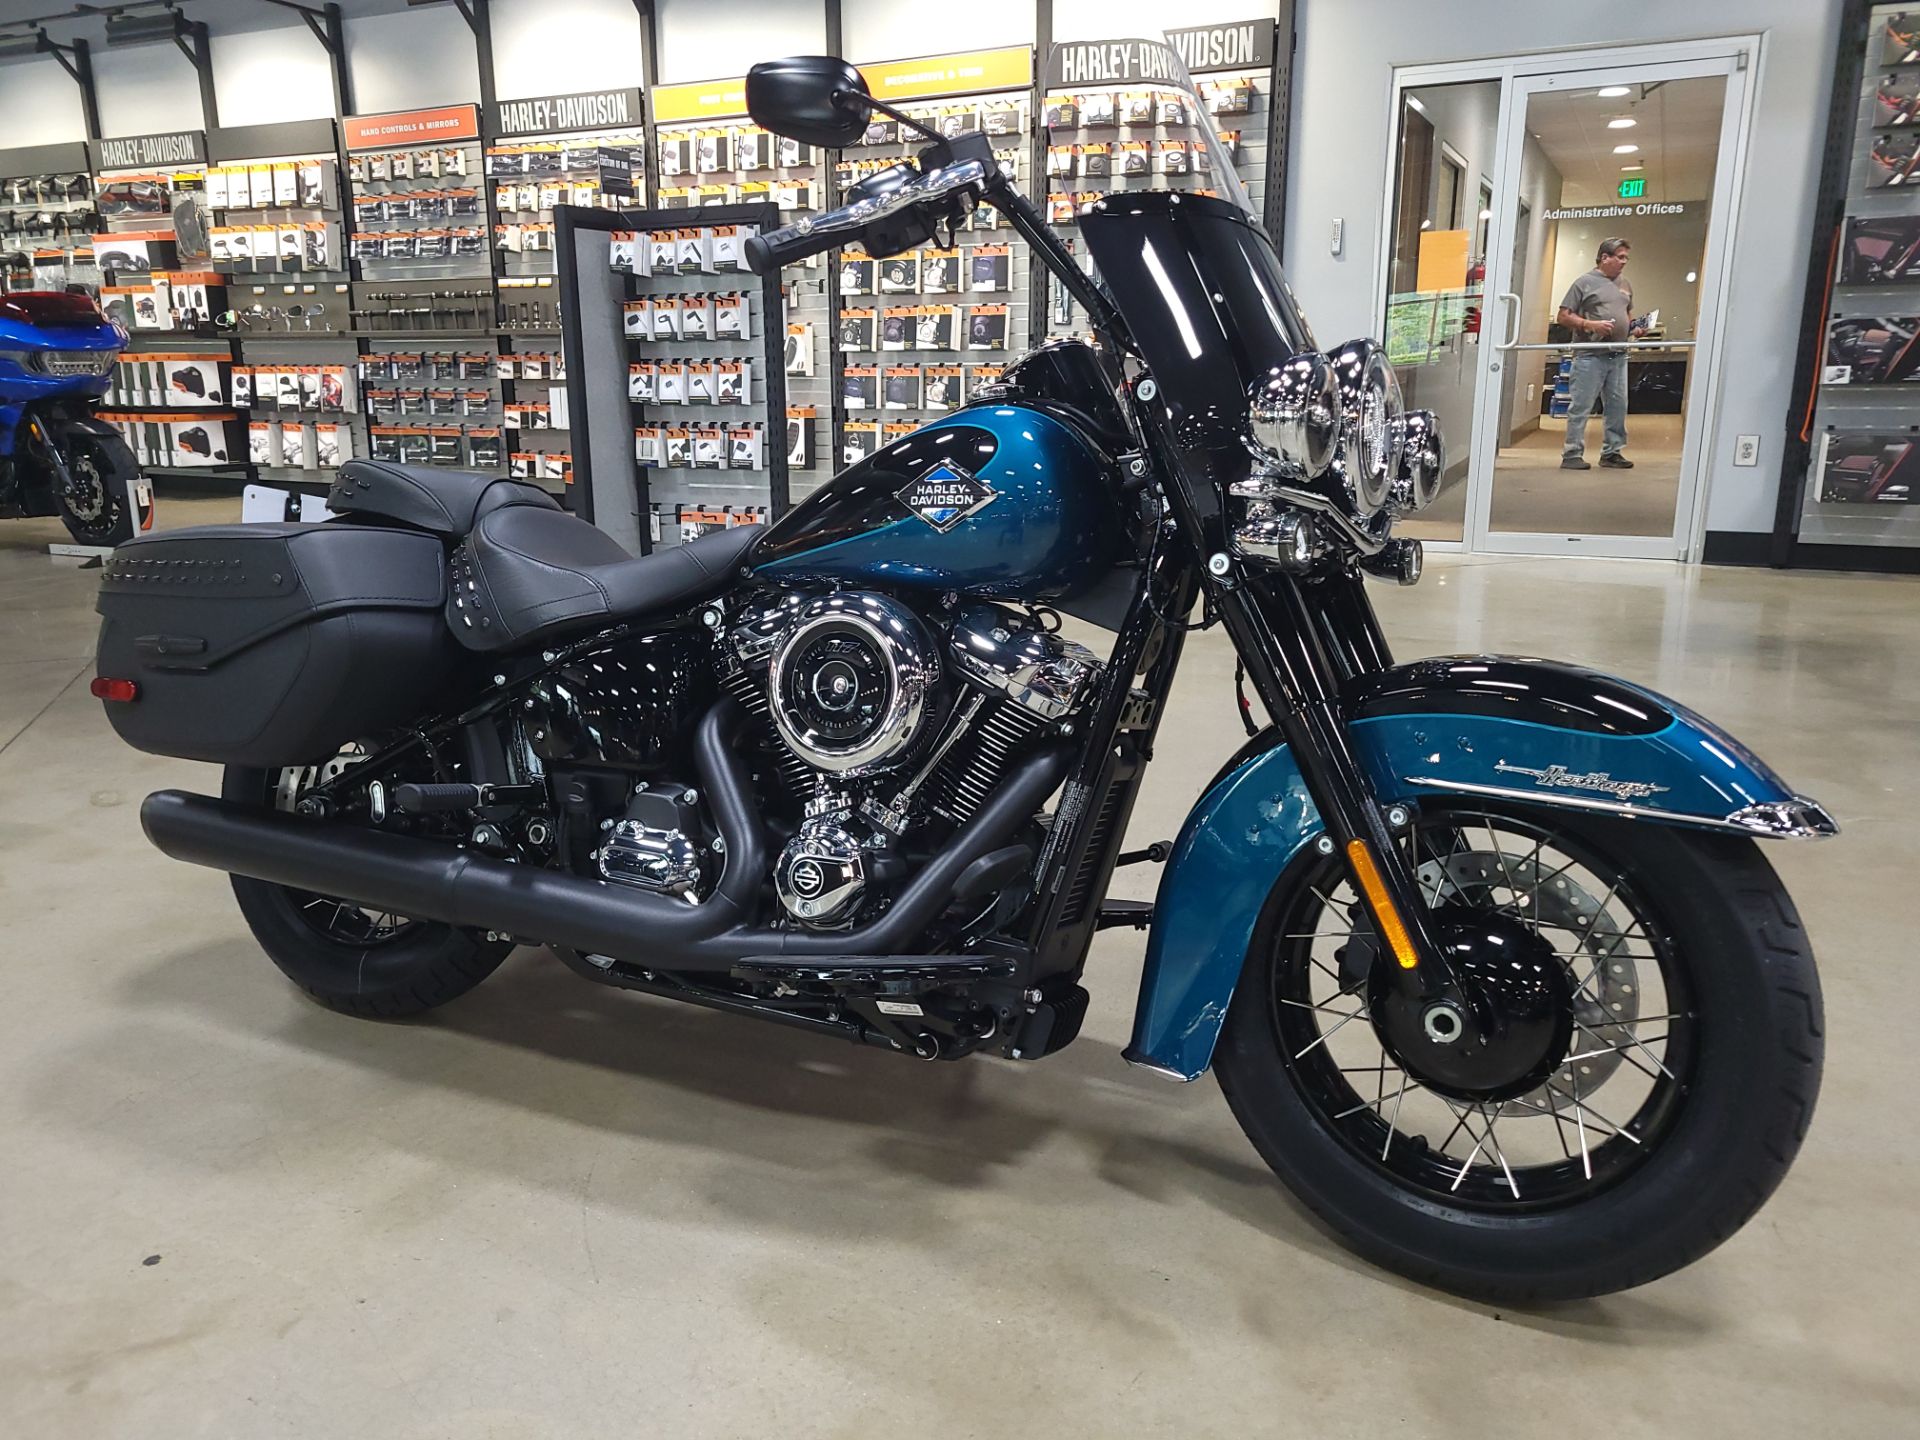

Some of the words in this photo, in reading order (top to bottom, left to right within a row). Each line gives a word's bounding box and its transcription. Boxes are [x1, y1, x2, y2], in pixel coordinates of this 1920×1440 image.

[500, 93, 629, 133] HARLEY-DAVIDSON
[360, 127, 380, 137] HAND
[381, 123, 417, 135] CONTROLS
[418, 122, 425, 131] &
[426, 118, 460, 130] MIRRORS
[100, 134, 196, 167] HARLEY-DAVIDSON
[1622, 179, 1645, 198] EXIT
[1542, 206, 1633, 220] Administrative
[1635, 203, 1685, 216] Offices
[917, 484, 971, 494] HARLEY-
[910, 495, 974, 505] DAVIDSON
[825, 639, 861, 653] 117
